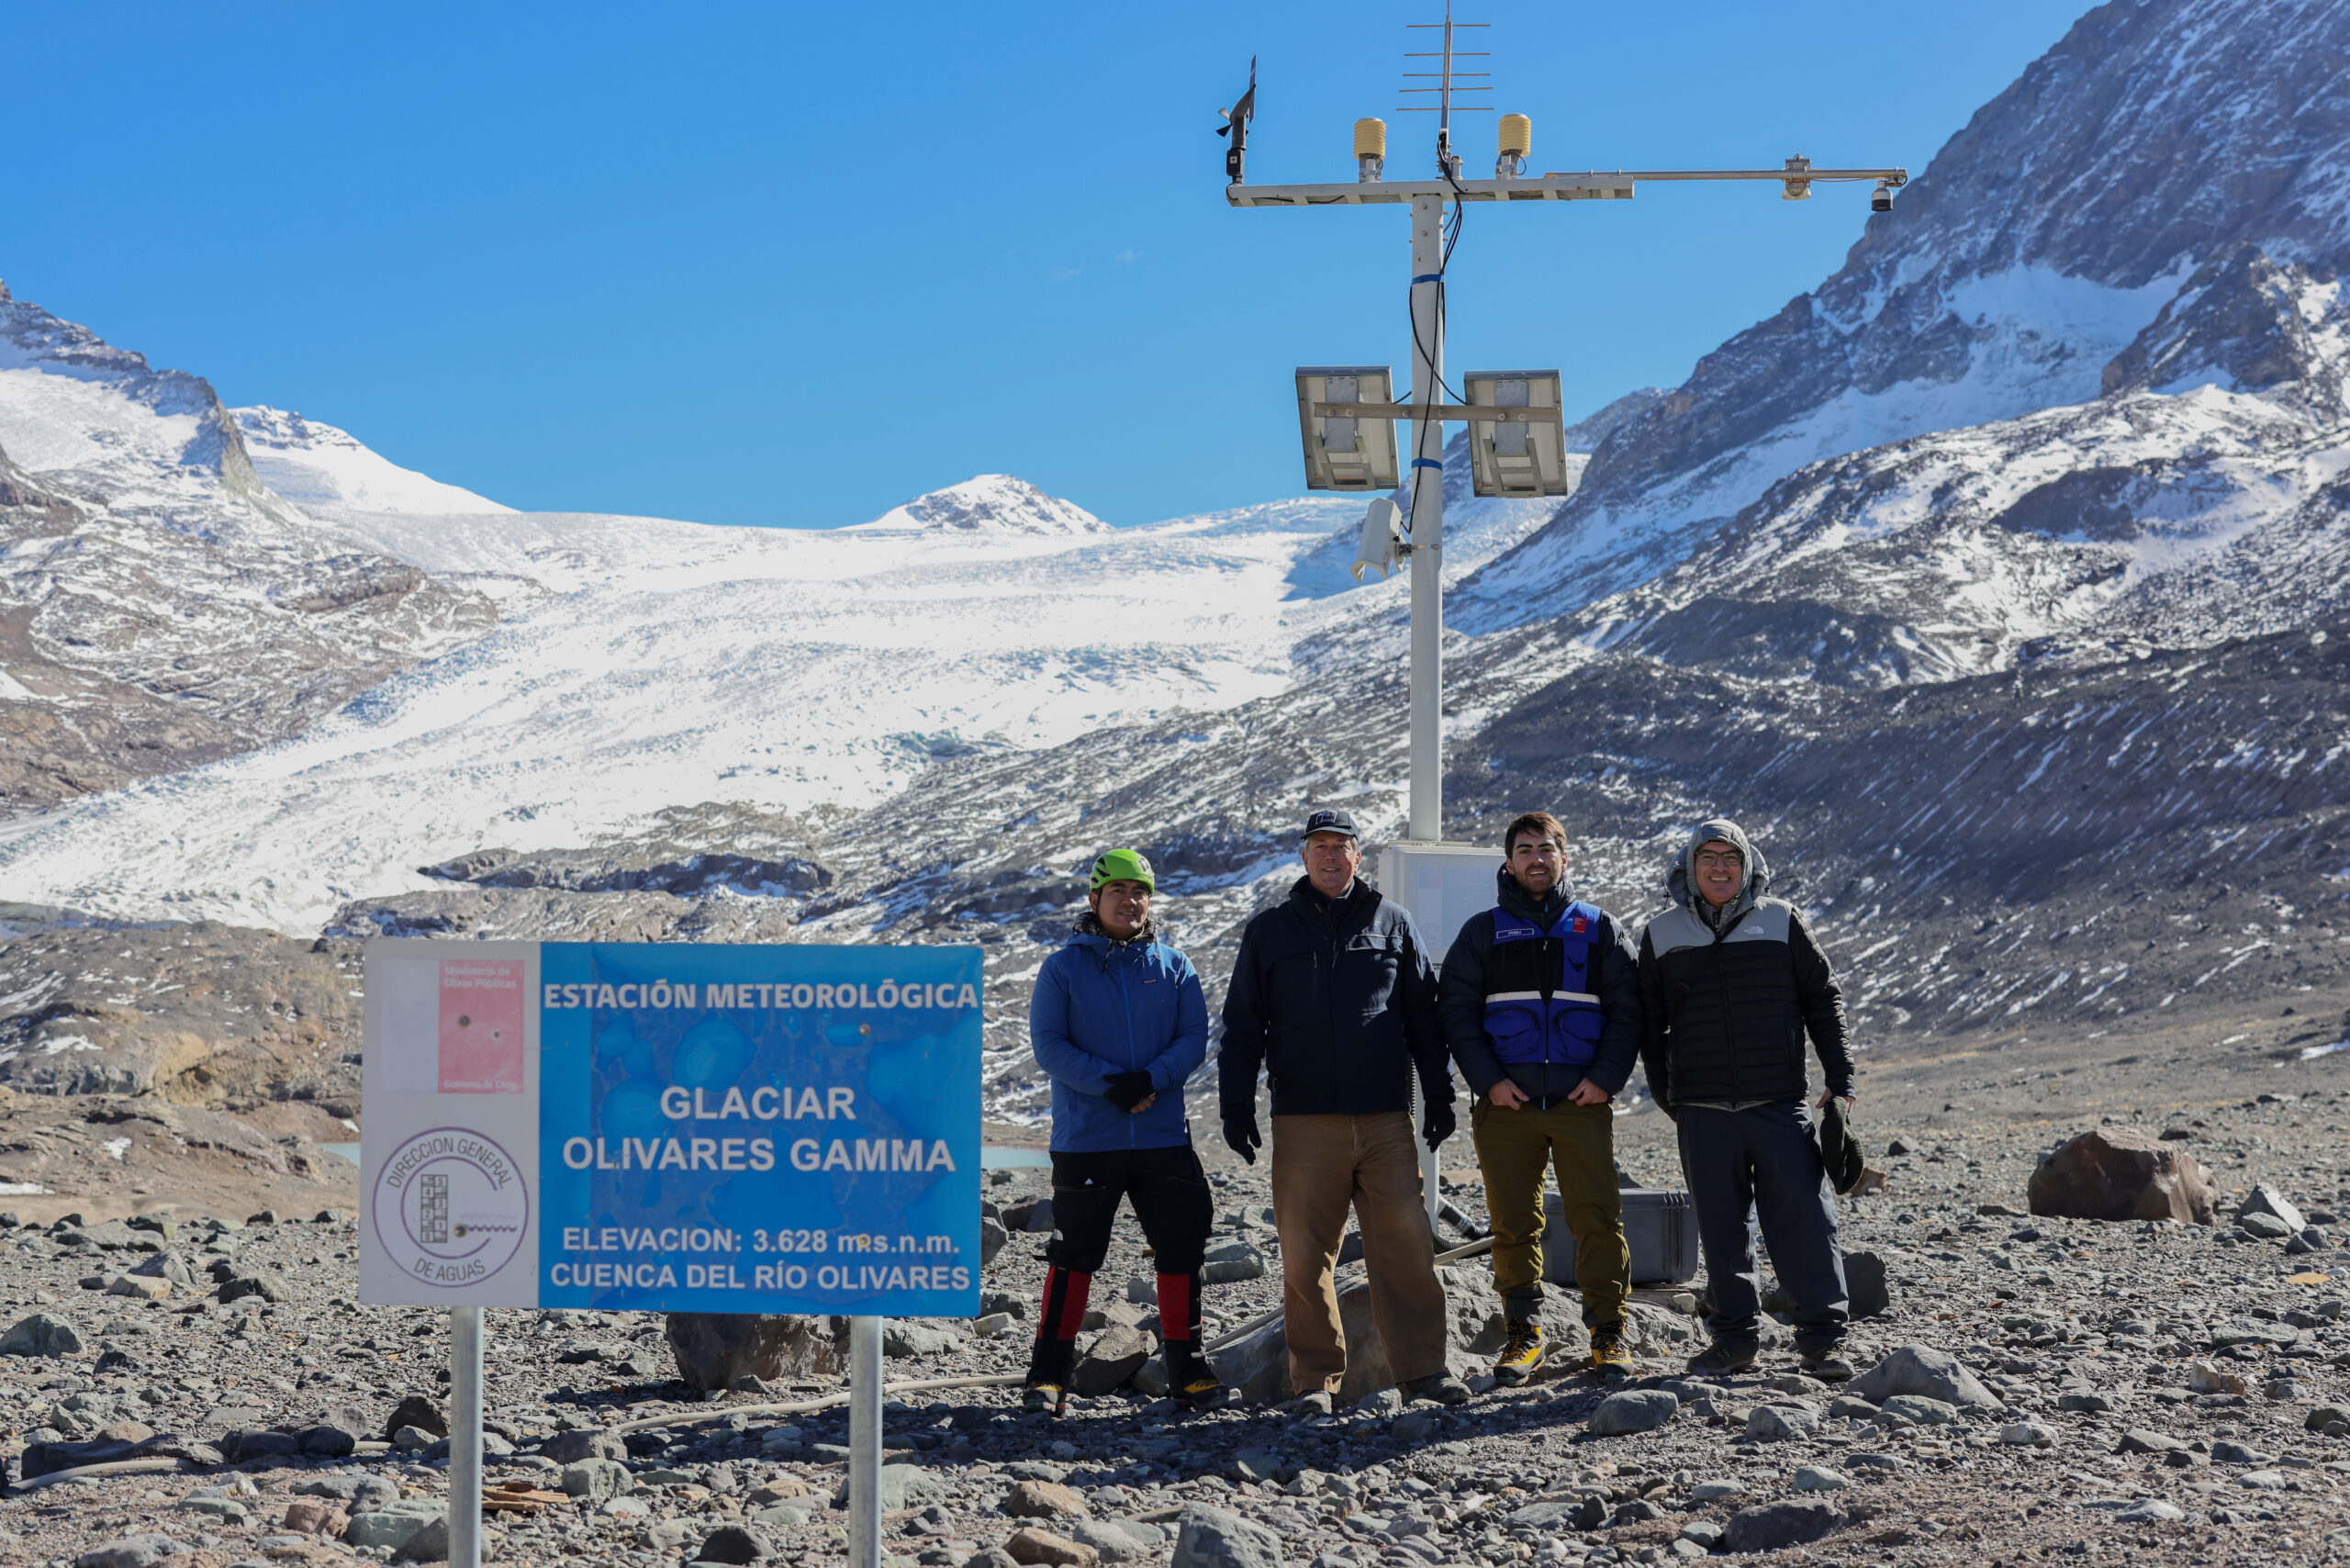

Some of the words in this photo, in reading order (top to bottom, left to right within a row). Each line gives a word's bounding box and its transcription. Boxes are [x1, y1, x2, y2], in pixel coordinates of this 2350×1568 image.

[443, 978, 473, 988] Obras
[544, 979, 697, 1009] ESTACIÓN
[706, 979, 979, 1009] METEOROLÓGICA
[660, 1086, 856, 1120] GLACIAR
[386, 1137, 454, 1189] DIRECCION
[458, 1138, 512, 1190] GENERAL
[563, 1137, 776, 1171] OLIVARES
[789, 1138, 957, 1172] GAMMA
[563, 1227, 742, 1252] ELEVACION:
[753, 1229, 827, 1252] 3.628
[414, 1258, 435, 1277] DE
[435, 1259, 486, 1282] AGUAS
[551, 1262, 678, 1287] CUENCA
[687, 1265, 745, 1289] DEL
[755, 1260, 808, 1289] RÍO
[818, 1265, 970, 1290] OLIVARES
